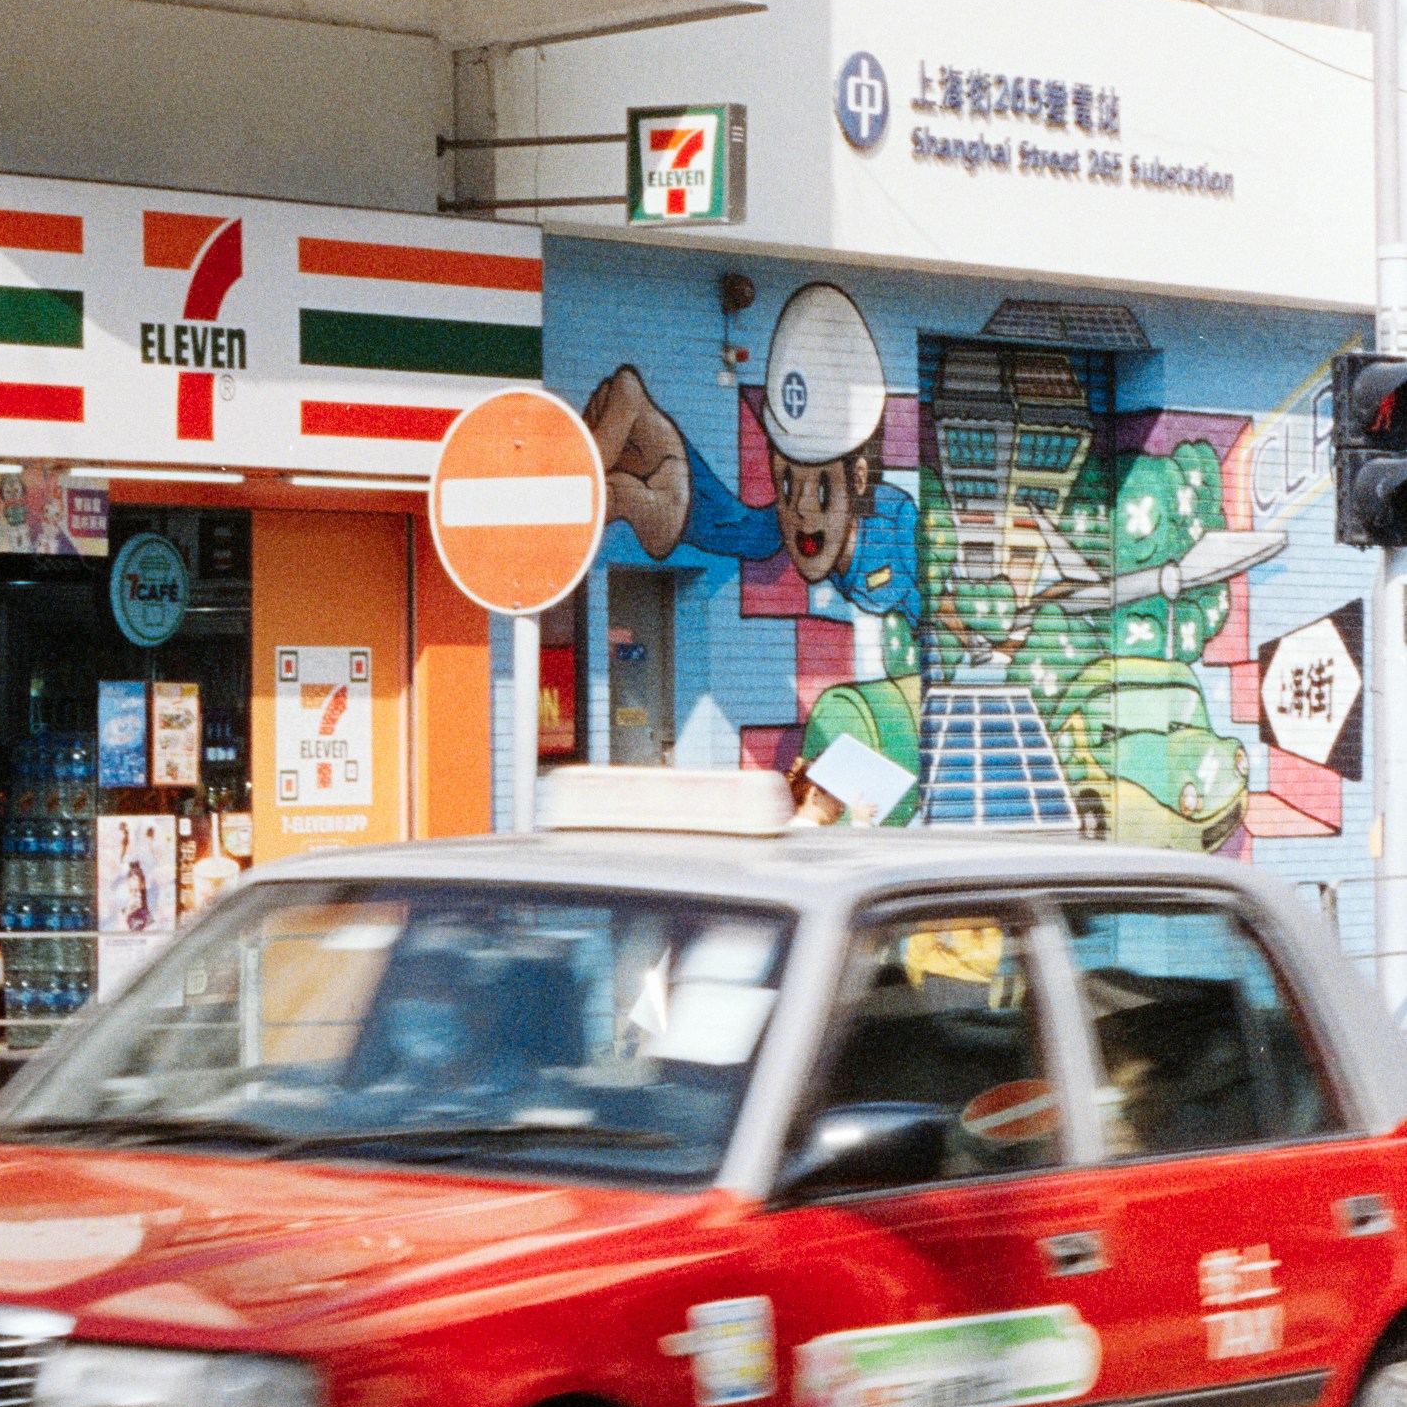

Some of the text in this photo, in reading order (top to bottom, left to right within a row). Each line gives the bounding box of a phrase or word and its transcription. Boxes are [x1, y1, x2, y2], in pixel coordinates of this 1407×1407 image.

[650, 129, 704, 215] 7
[910, 126, 1011, 176] Shanghai
[1018, 140, 1081, 180] Street
[1129, 154, 1235, 200] Substation
[143, 210, 243, 441] 7
